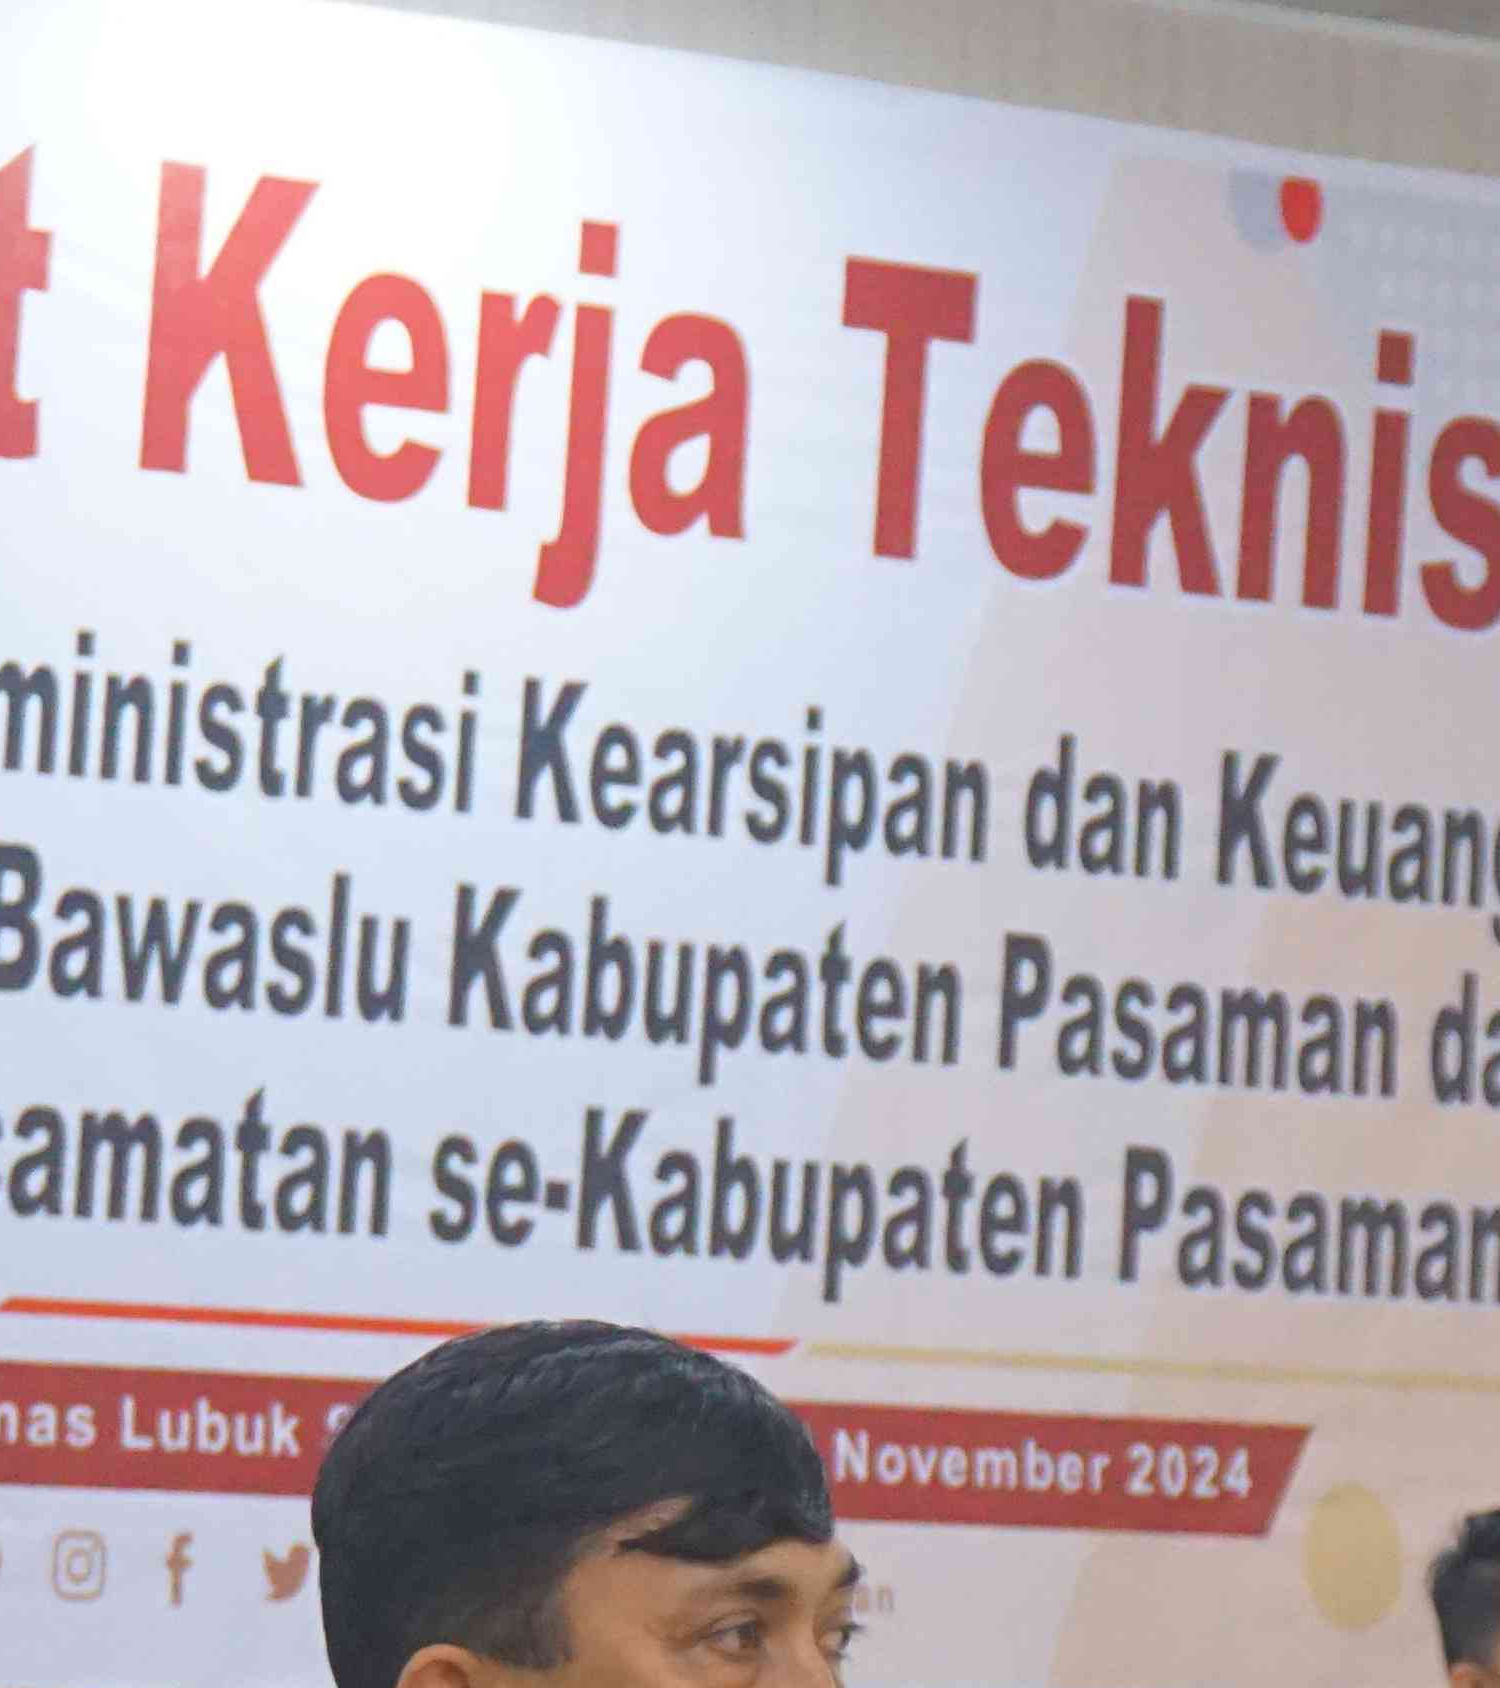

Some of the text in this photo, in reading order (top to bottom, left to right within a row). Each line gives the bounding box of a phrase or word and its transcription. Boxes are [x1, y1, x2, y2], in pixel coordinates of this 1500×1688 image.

[138, 160, 750, 609] Kerja
[513, 677, 989, 887] Kearsipan
[1024, 734, 1183, 880] dan
[447, 882, 963, 1086] Kabupaten
[997, 932, 1397, 1099] Pasaman
[428, 1106, 1085, 1302] se-Kabupaten
[119, 1395, 301, 1457] Lubuk
[833, 1429, 1252, 1498] November 2024
